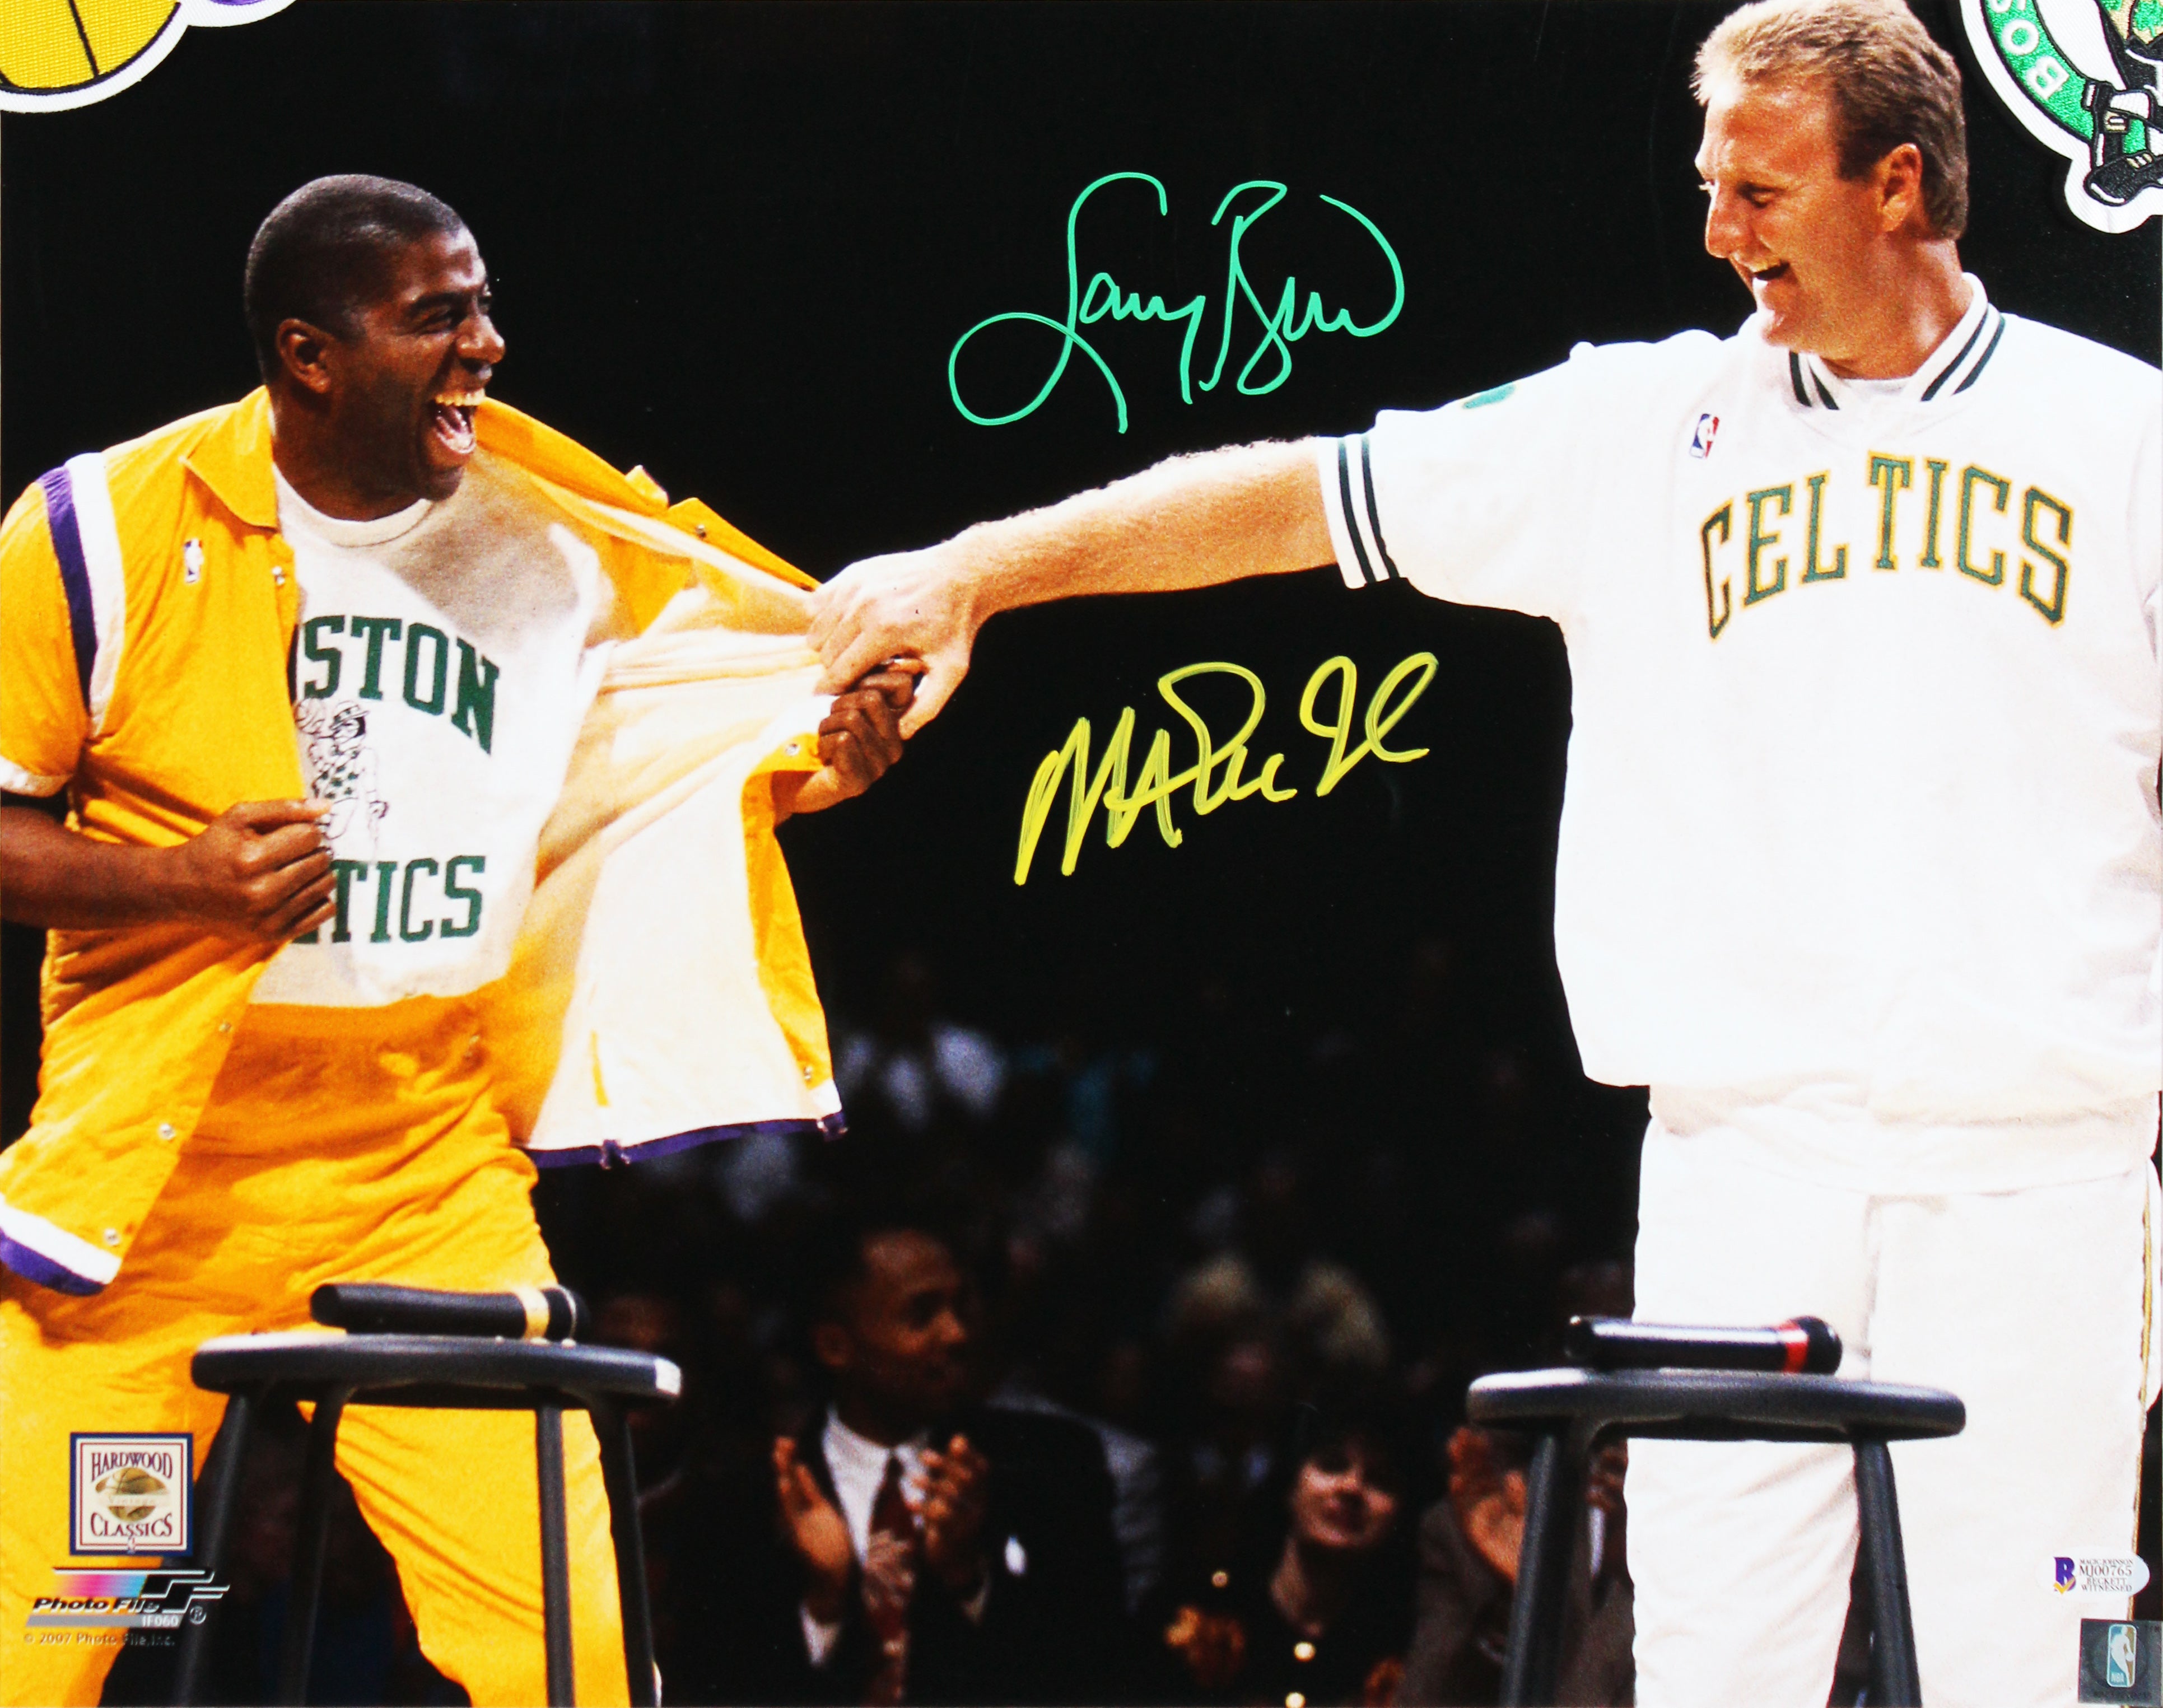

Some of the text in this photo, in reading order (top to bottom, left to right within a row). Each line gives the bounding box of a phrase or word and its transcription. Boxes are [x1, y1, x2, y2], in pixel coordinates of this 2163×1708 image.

[1700, 450, 2075, 643] CELTICS
[287, 615, 500, 756] STON
[291, 855, 486, 944] TICS
[2080, 1565, 2132, 1577] MJ00765
